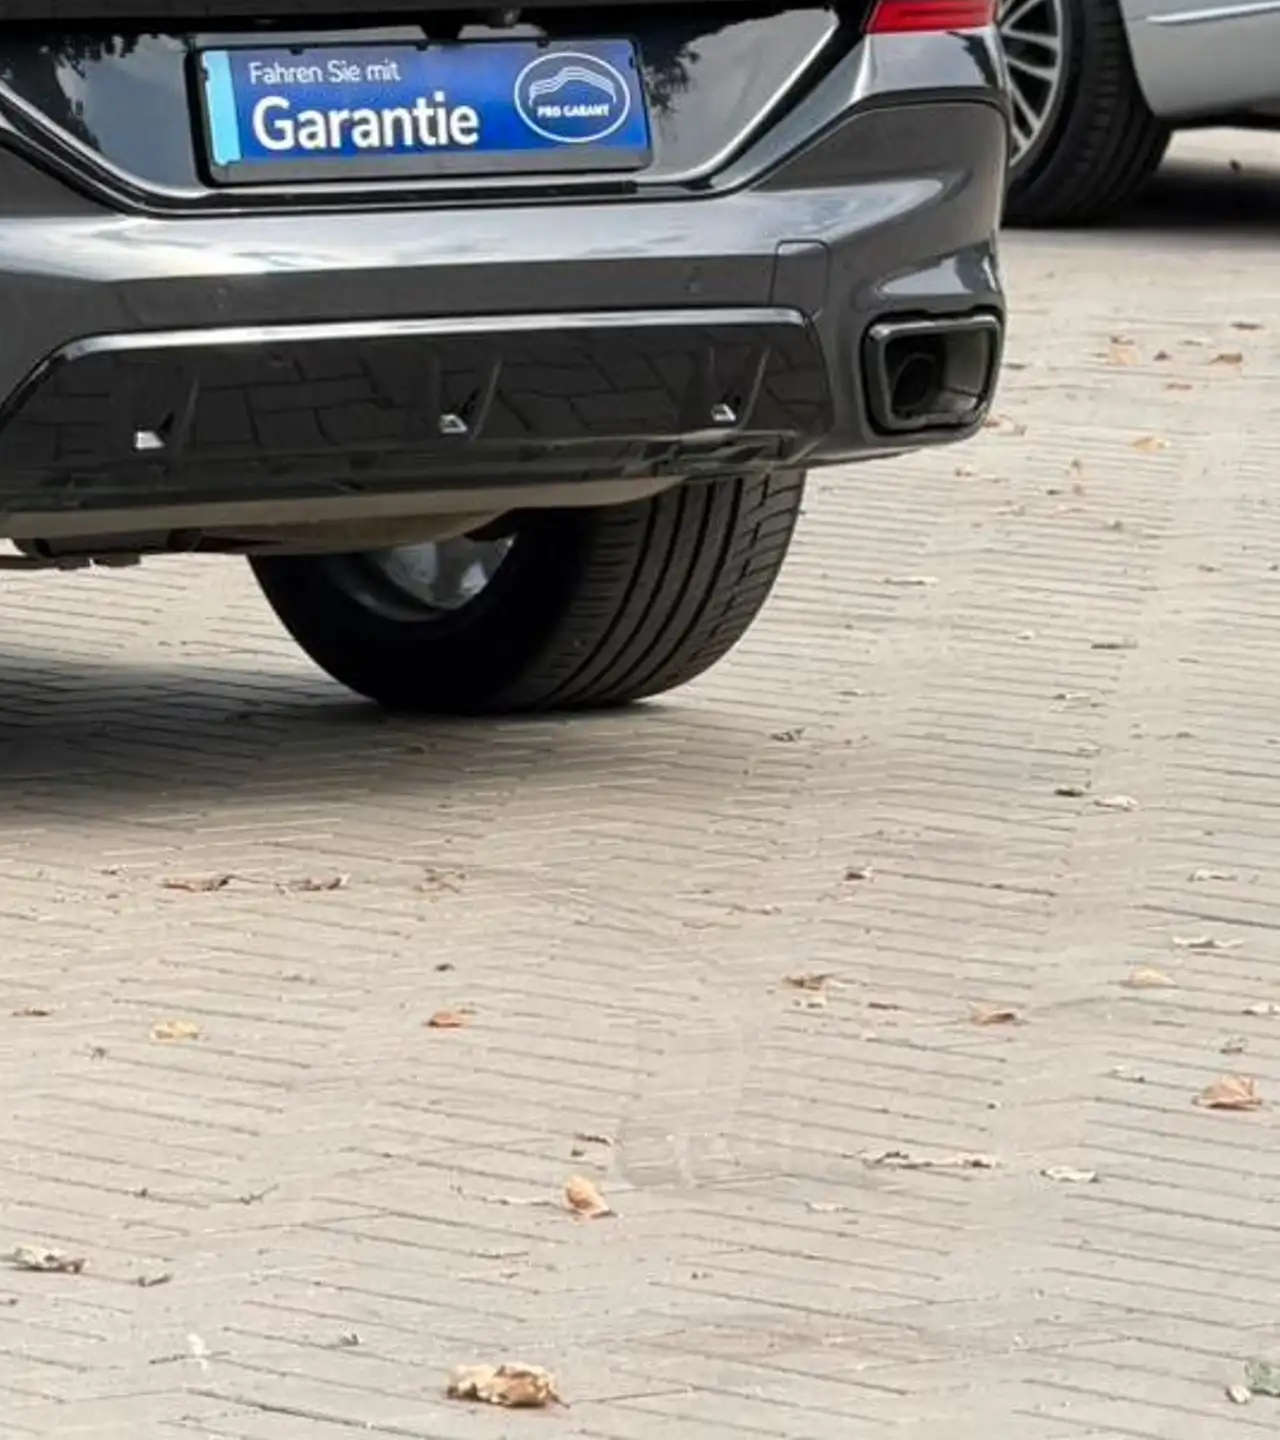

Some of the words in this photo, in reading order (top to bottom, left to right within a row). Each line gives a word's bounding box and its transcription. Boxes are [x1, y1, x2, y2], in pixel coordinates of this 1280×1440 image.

[248, 62, 323, 85] Fahren
[326, 60, 361, 82] Sie
[365, 58, 402, 81] mit
[252, 91, 480, 150] Garantie
